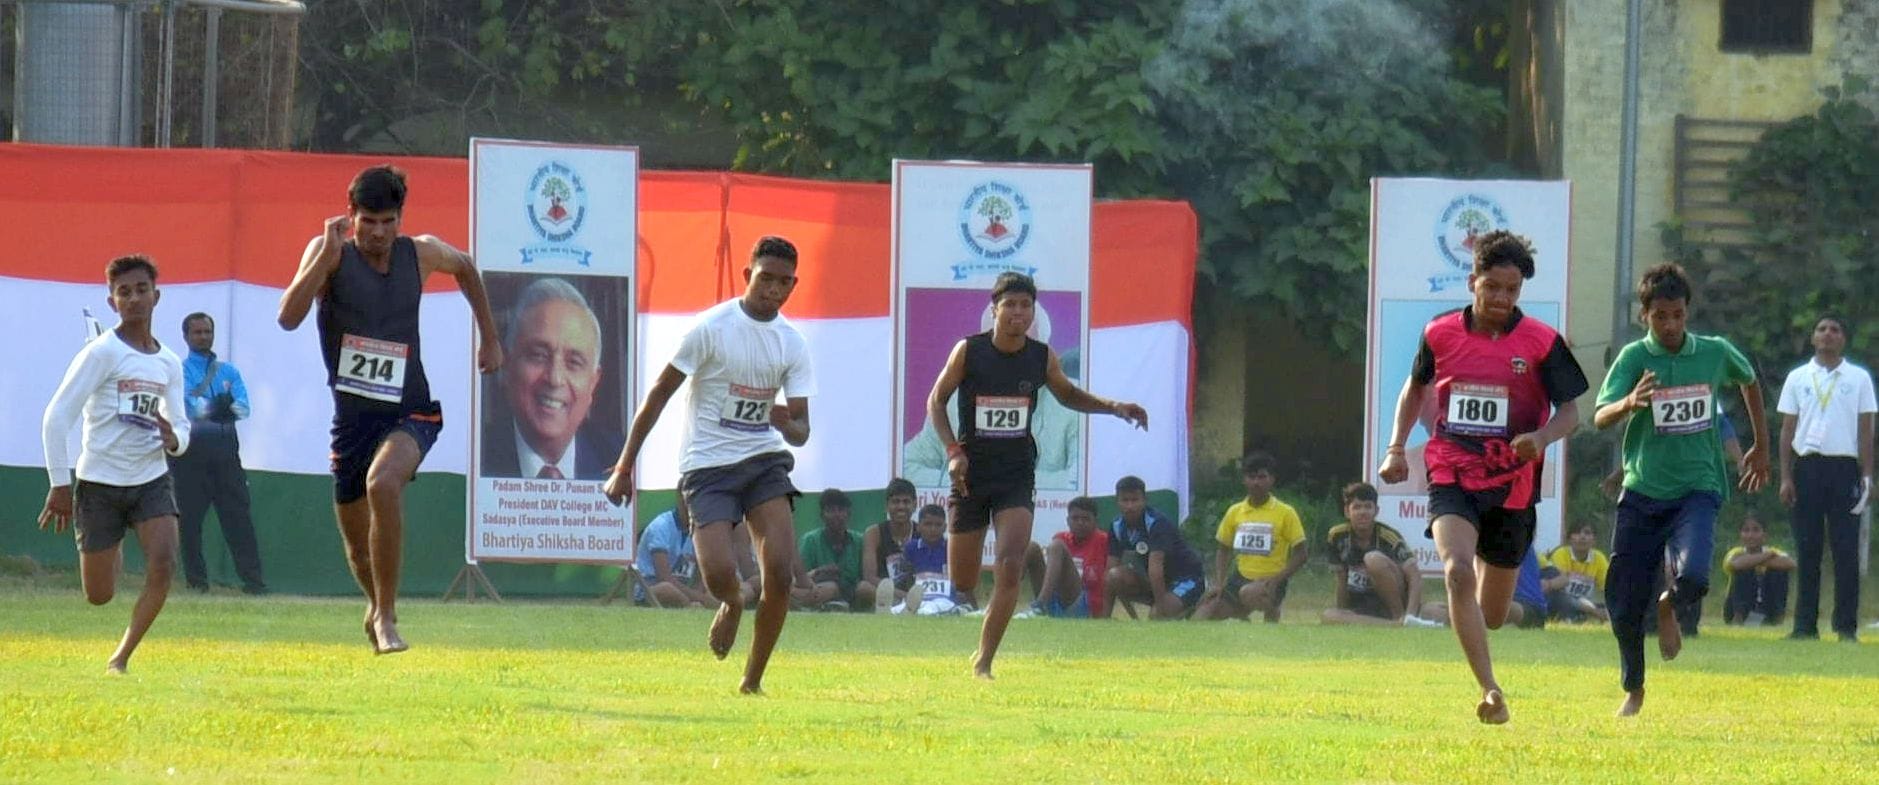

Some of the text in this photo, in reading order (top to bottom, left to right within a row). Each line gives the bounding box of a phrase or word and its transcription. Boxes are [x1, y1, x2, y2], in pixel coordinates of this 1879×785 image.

[350, 353, 394, 382] 214
[128, 393, 159, 417] 150
[734, 400, 767, 421] 123
[1456, 398, 1497, 422] 180
[1661, 399, 1705, 423] 230
[984, 409, 1020, 428] 129
[493, 480, 521, 492] Padam
[524, 480, 548, 492] Shree
[551, 482, 563, 493] Dr.
[566, 482, 594, 493] Punam
[499, 498, 608, 513] President DAV College MC
[483, 513, 624, 529] Sadasya (Executive Board Member)
[482, 532, 624, 550] Bhartiya Shiksha Board
[1241, 534, 1264, 548] 125
[922, 581, 945, 593] 231
